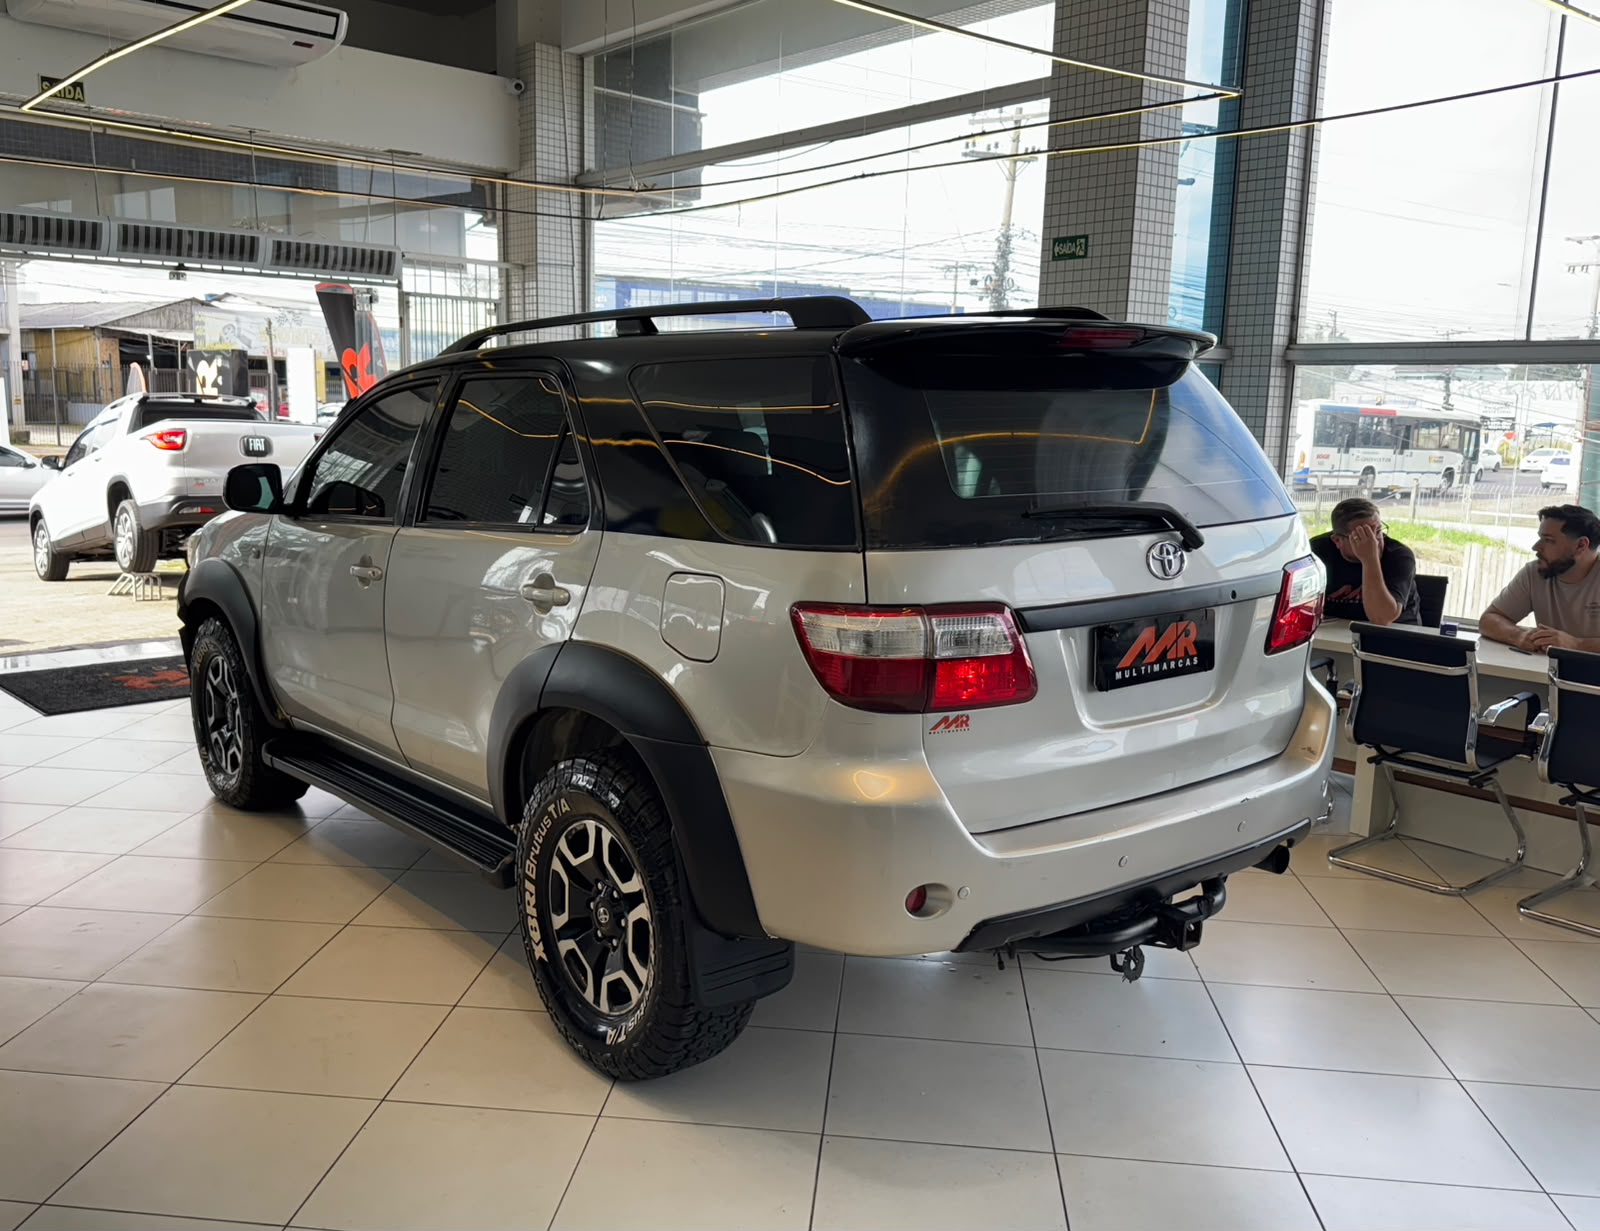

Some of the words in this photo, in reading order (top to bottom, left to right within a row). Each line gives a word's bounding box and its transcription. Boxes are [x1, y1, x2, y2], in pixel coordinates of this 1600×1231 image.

[248, 438, 265, 452] FIAT
[1116, 621, 1198, 669] MR
[1115, 656, 1199, 680] MULTIMARCAS
[547, 798, 571, 820] T/A
[525, 818, 552, 880] Brutus
[525, 878, 548, 962] XBRI
[606, 1022, 627, 1047] T/A
